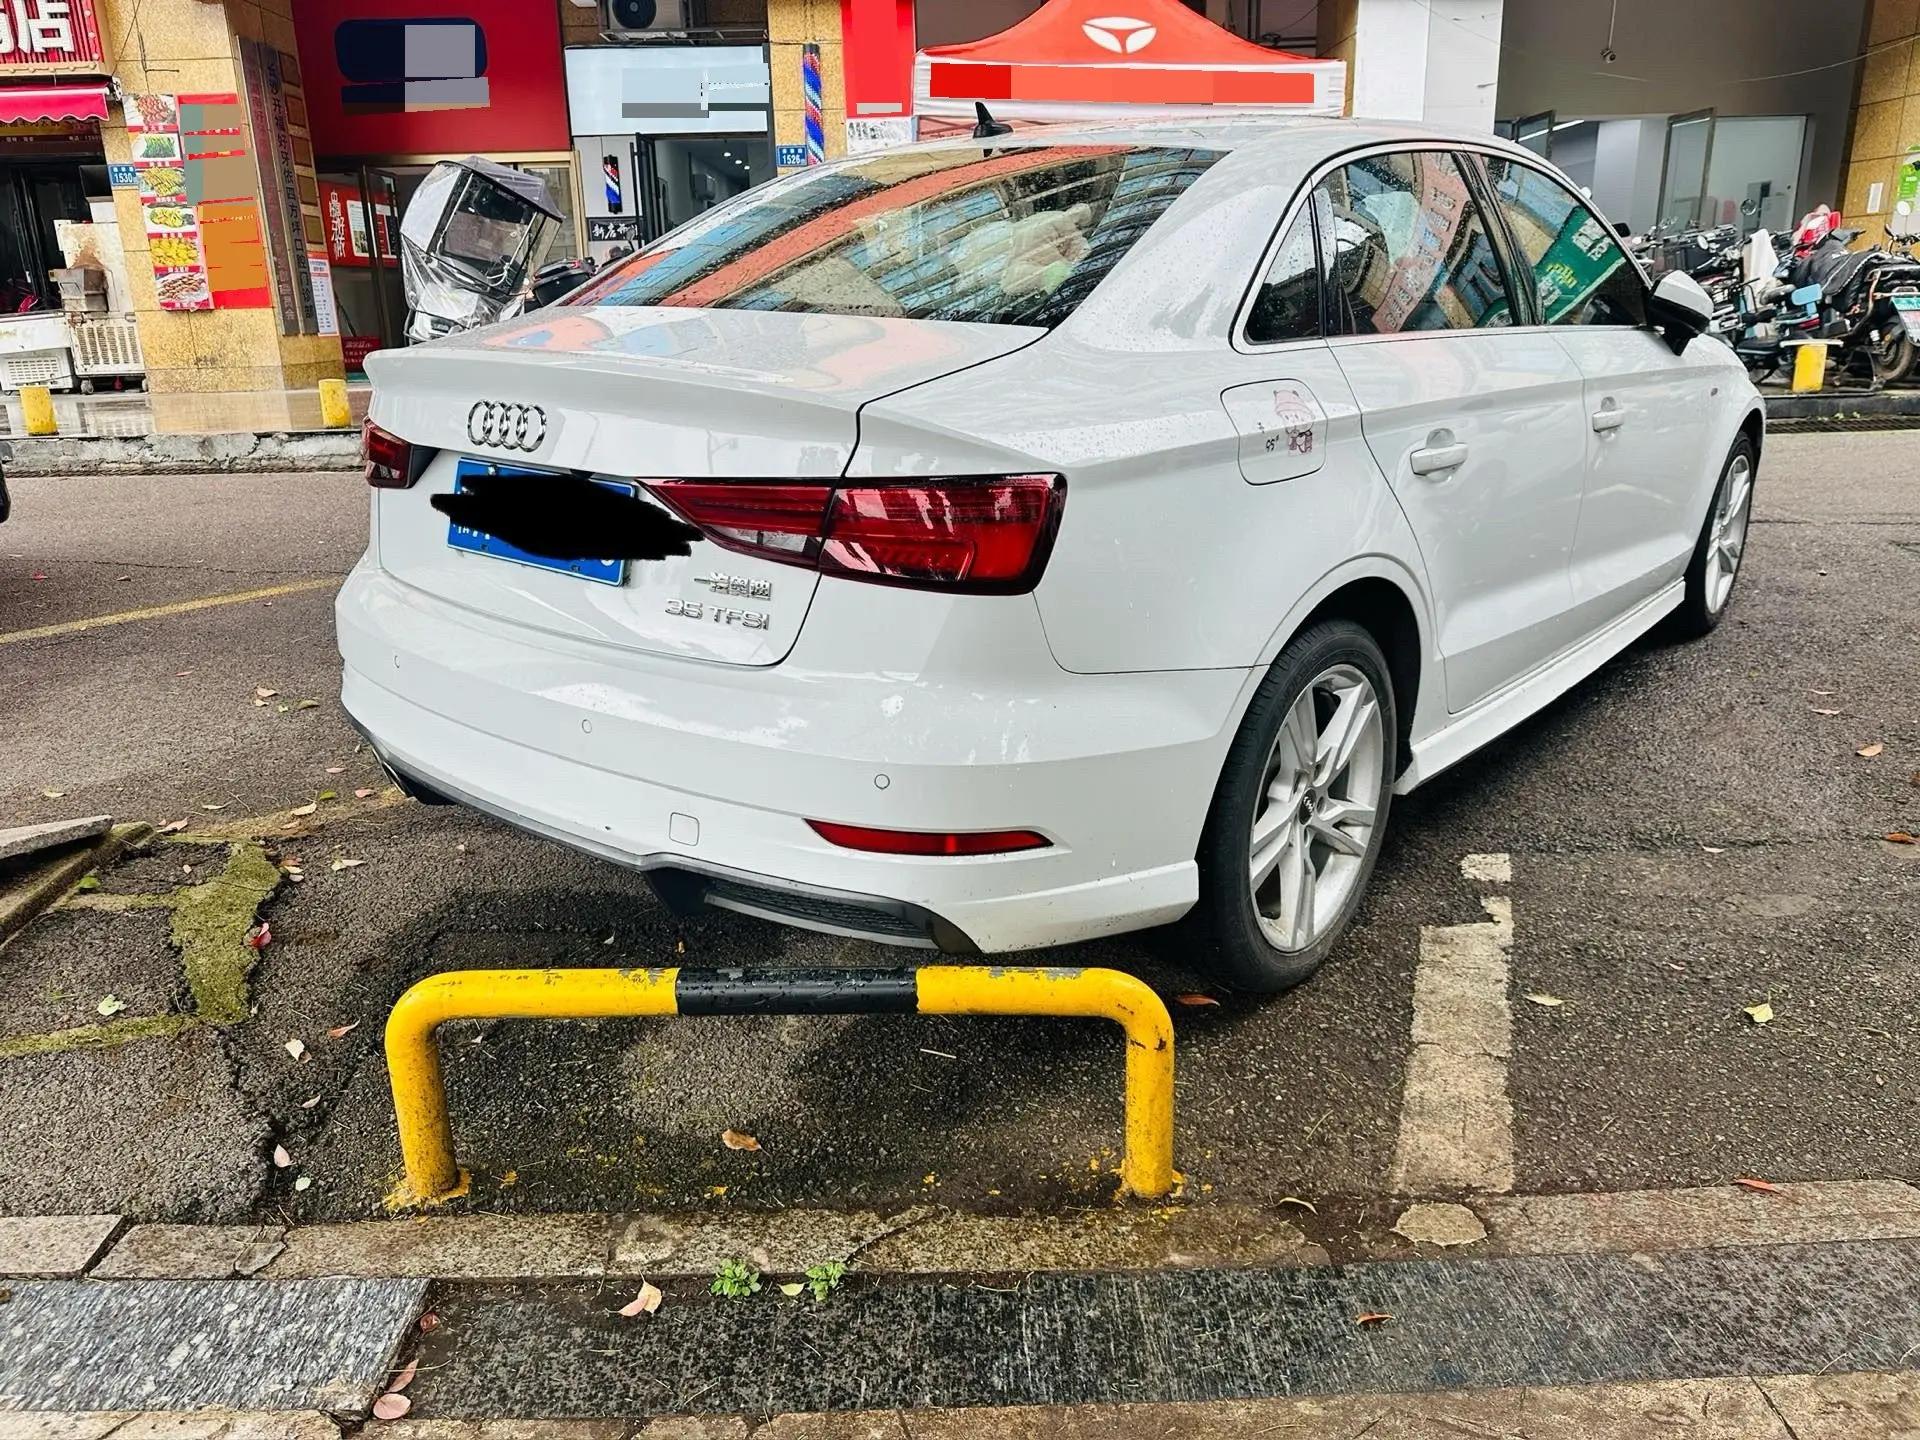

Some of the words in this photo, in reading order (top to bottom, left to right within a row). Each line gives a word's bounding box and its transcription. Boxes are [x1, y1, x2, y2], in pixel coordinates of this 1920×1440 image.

[0, 0, 75, 53] 店
[665, 598, 703, 619] 35
[709, 605, 770, 631] TFSI
